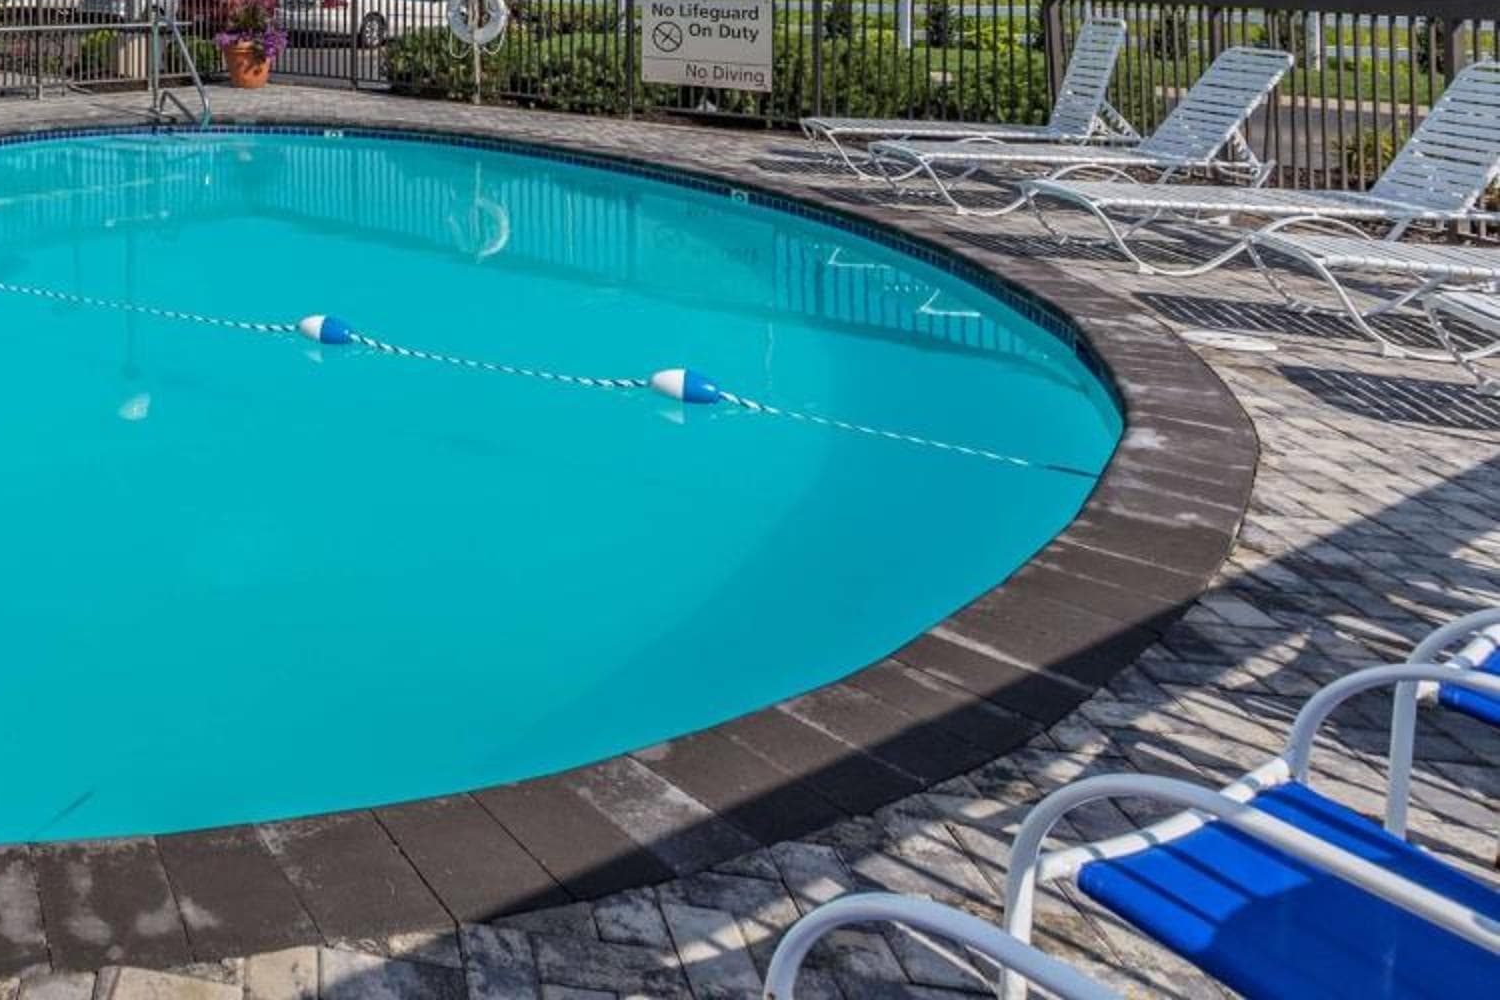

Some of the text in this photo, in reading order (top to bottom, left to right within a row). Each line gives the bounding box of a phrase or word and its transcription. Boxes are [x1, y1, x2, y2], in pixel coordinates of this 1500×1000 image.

[652, 3, 759, 22] No Lifeguard
[689, 23, 759, 43] On Duty
[685, 63, 765, 85] No Diving
